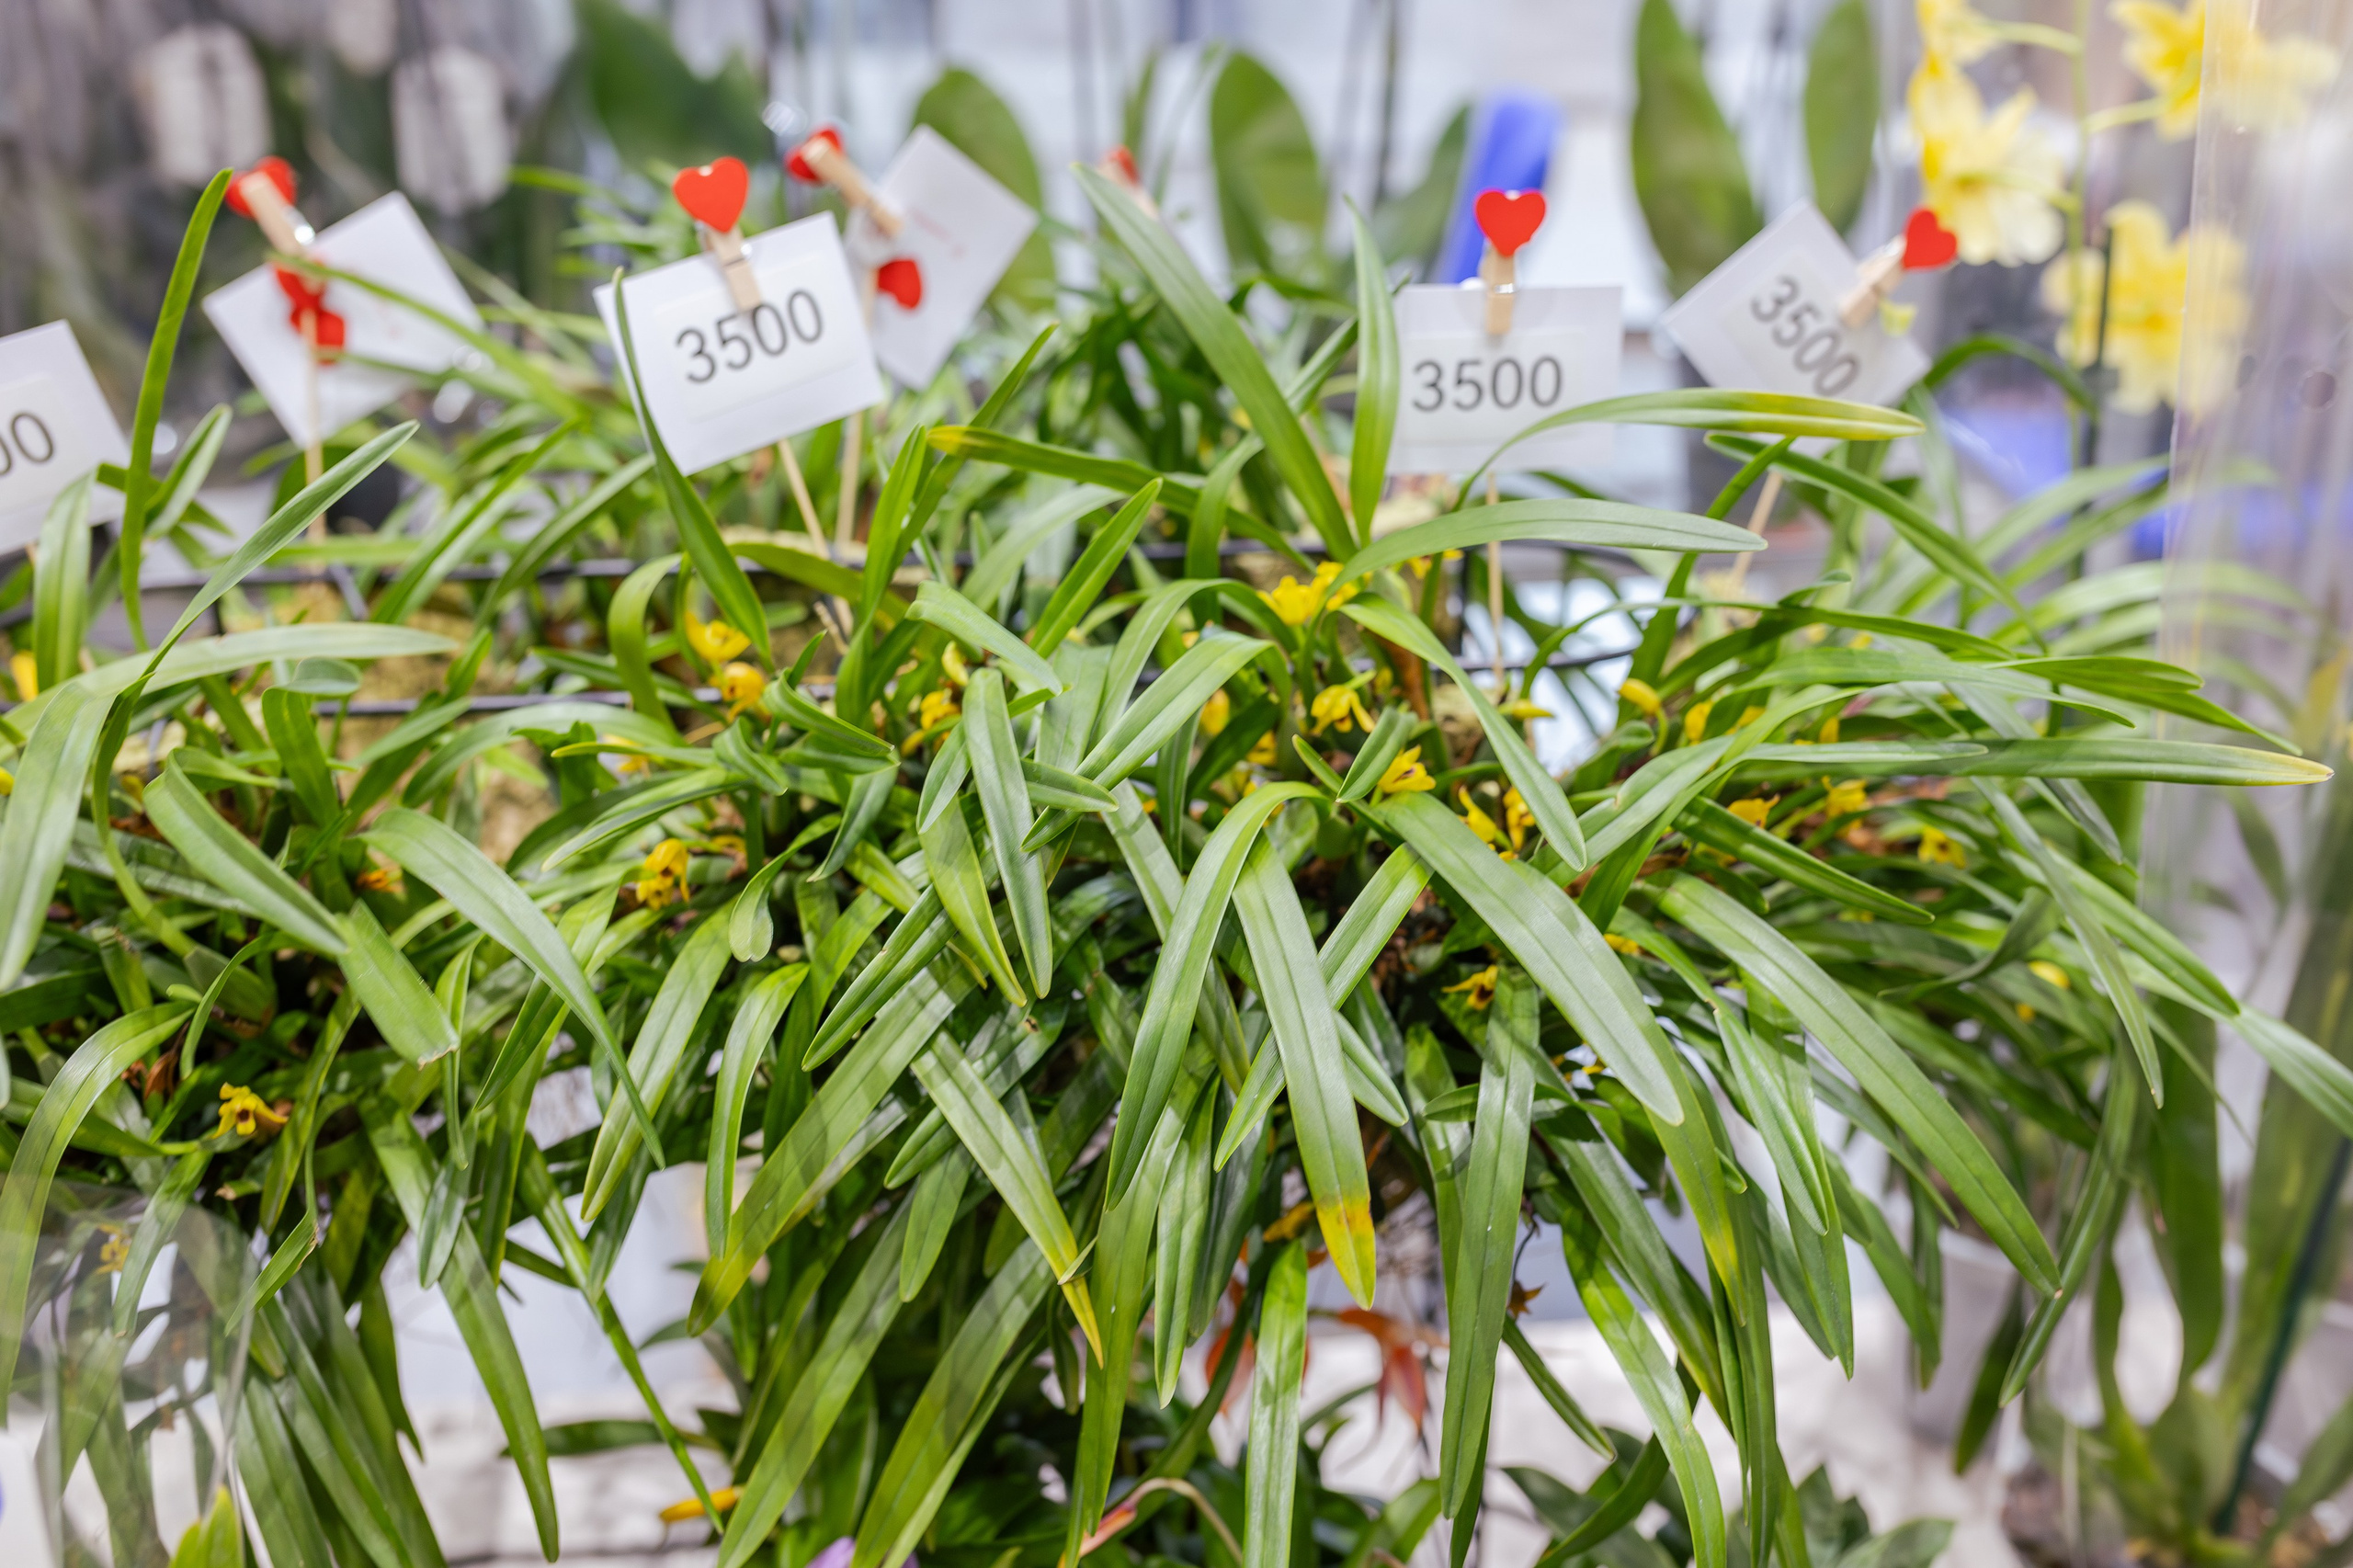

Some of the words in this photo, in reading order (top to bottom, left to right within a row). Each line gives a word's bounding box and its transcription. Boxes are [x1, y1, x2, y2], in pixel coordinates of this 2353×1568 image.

[676, 289, 823, 383] 3500
[1750, 277, 1860, 397] 3500
[1413, 356, 1562, 412] 3500
[0, 412, 54, 476] 0
